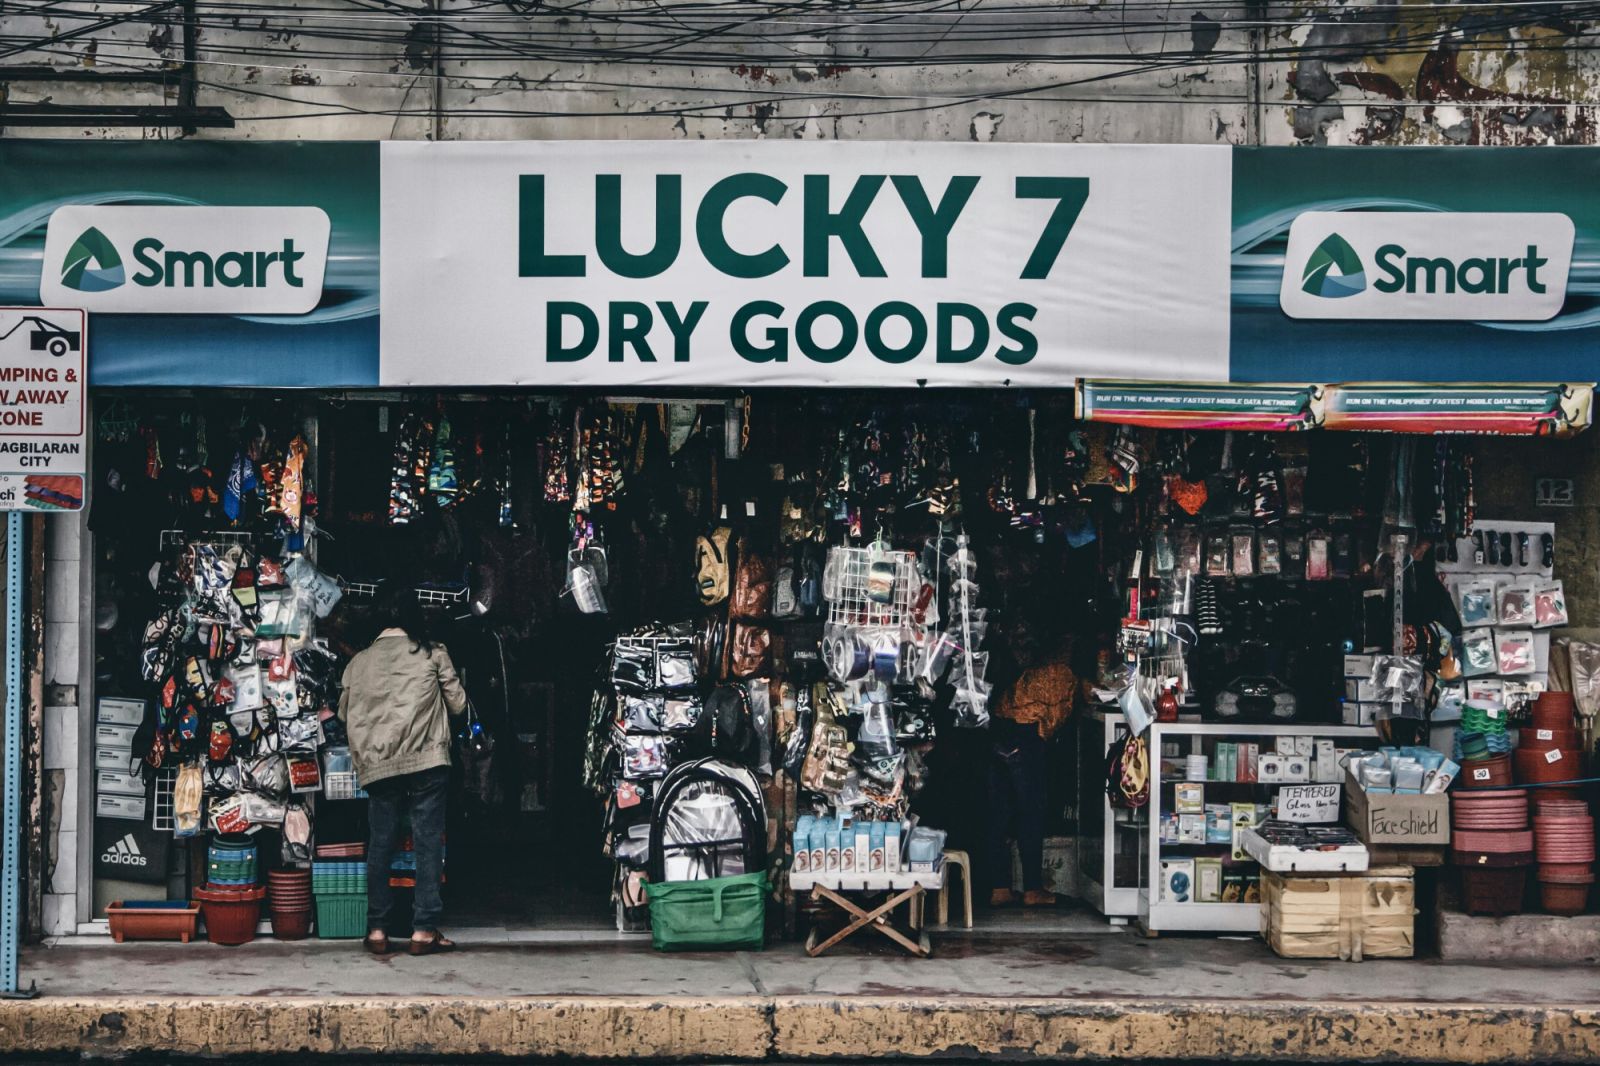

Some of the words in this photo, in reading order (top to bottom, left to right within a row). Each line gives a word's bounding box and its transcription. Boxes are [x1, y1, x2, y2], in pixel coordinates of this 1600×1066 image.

[519, 173, 981, 278] LUCKY
[1016, 177, 1089, 279] 7
[132, 238, 304, 287] Smart
[1373, 244, 1548, 294] Smart
[546, 301, 709, 362] DRY
[730, 300, 1038, 365] GOODS
[65, 368, 77, 382] &
[15, 390, 69, 404] AWAY
[1124, 395, 1137, 403] THE
[1183, 397, 1216, 405] FASTEST
[1243, 398, 1260, 406] DATA
[1262, 399, 1297, 407] NETWORK
[0, 411, 43, 426] ONE
[0, 443, 79, 453] AGBILARAN
[20, 456, 52, 467] CITY
[1282, 786, 1337, 799] TEMPERED
[101, 852, 147, 866] adidas
